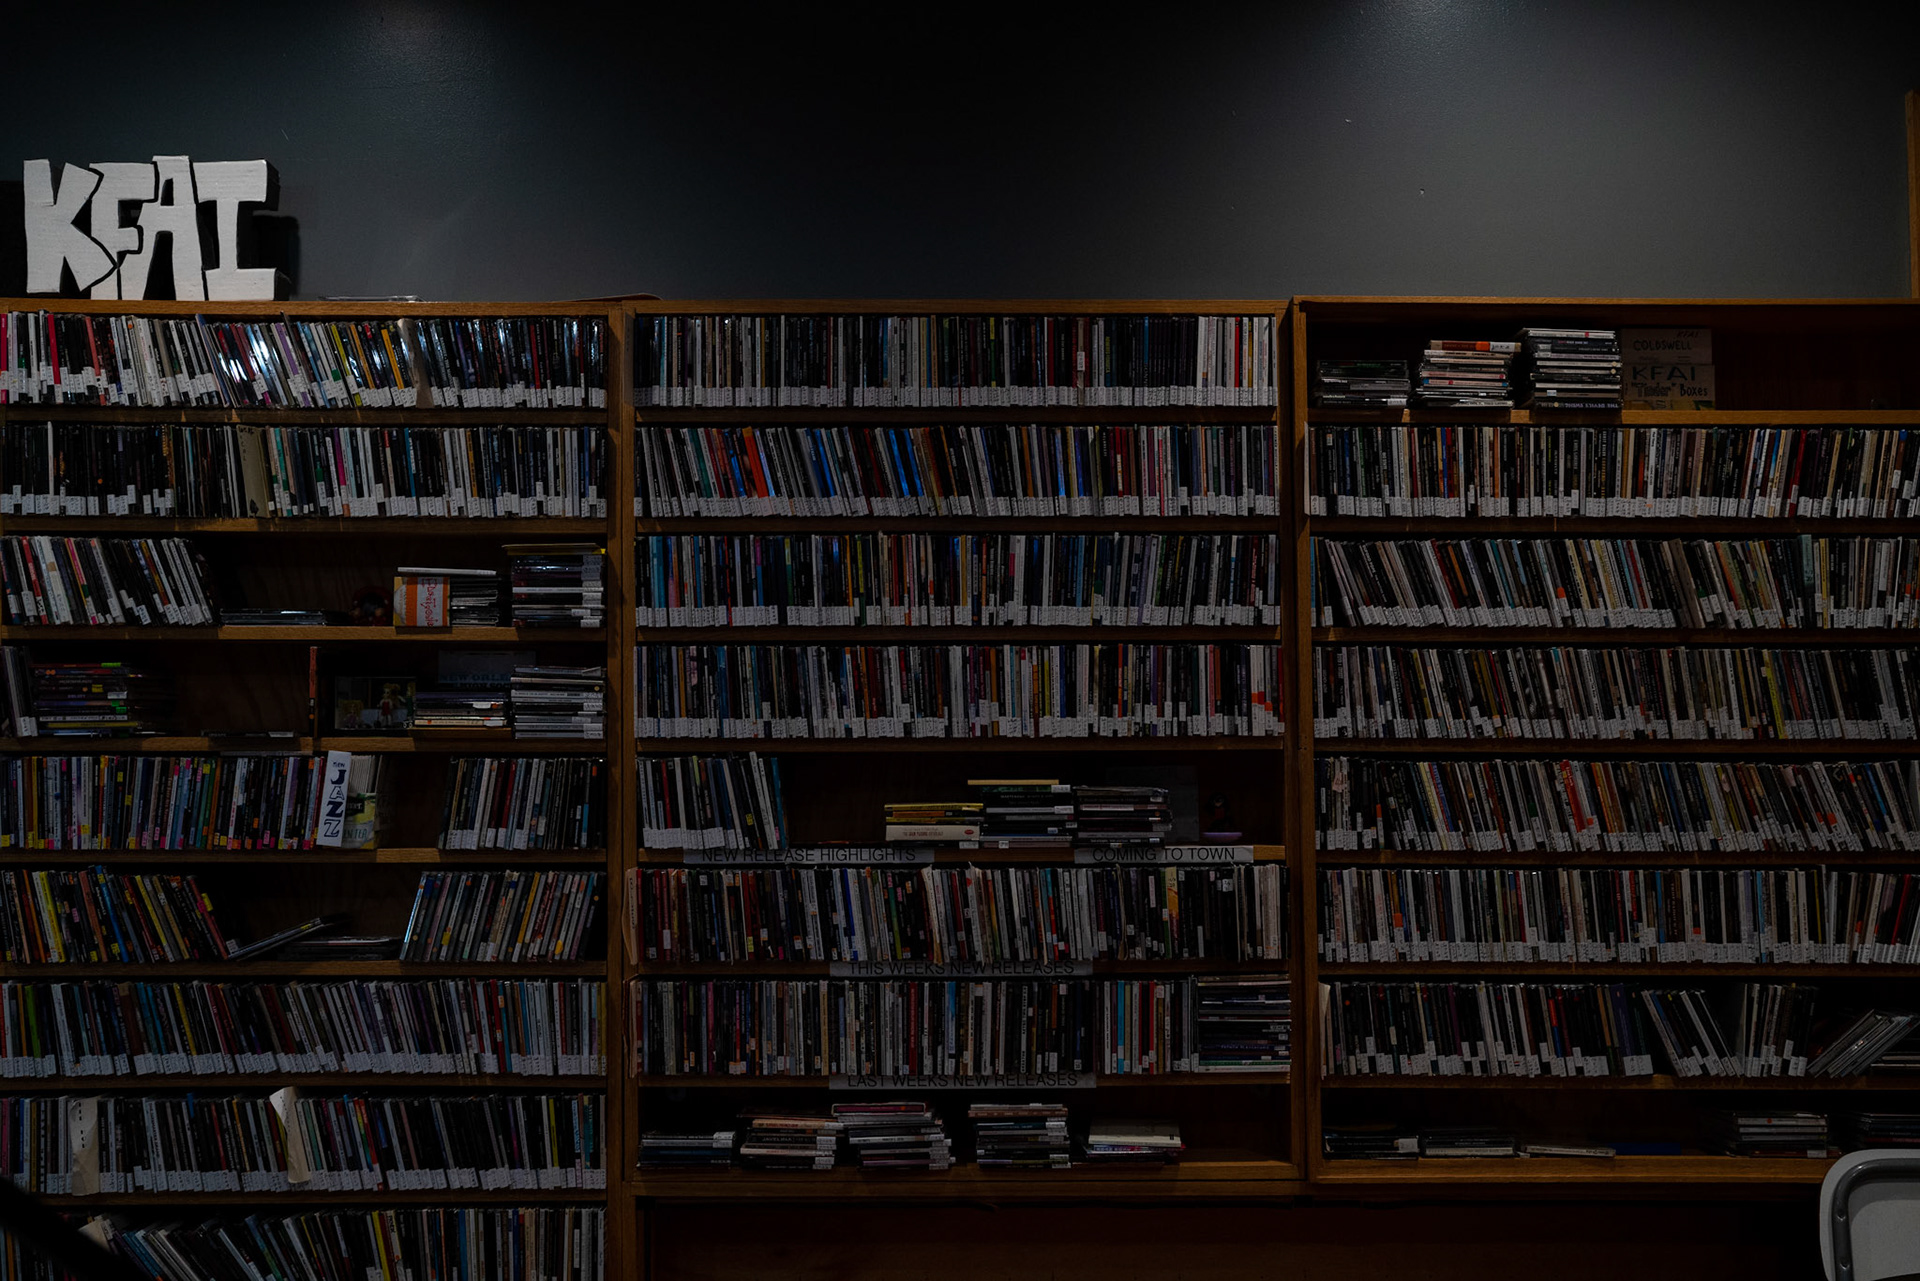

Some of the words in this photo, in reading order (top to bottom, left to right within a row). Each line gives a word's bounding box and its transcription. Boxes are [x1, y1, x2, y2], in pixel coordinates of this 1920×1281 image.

[23, 155, 277, 301] KFAI
[1633, 339, 1693, 351] COLDSWELL
[1631, 366, 1696, 381] KFAI
[1680, 383, 1708, 397] Boxes
[323, 769, 347, 838] JAZZ
[702, 849, 738, 862] NEW
[744, 849, 814, 862] RELEASE
[820, 848, 916, 862] HIGHLIGHTS
[1093, 847, 1157, 862] COMING
[1163, 847, 1183, 860] TO
[1189, 847, 1235, 860] TOWN
[850, 961, 884, 975] THIS
[888, 961, 945, 975] WEEKS
[950, 961, 986, 974] NEW
[992, 960, 1074, 974] RELEASES
[848, 1074, 885, 1087] LAST
[892, 1074, 948, 1087] WEEKS
[953, 1074, 989, 1087] NEW
[995, 1073, 1078, 1087] RELEASES
